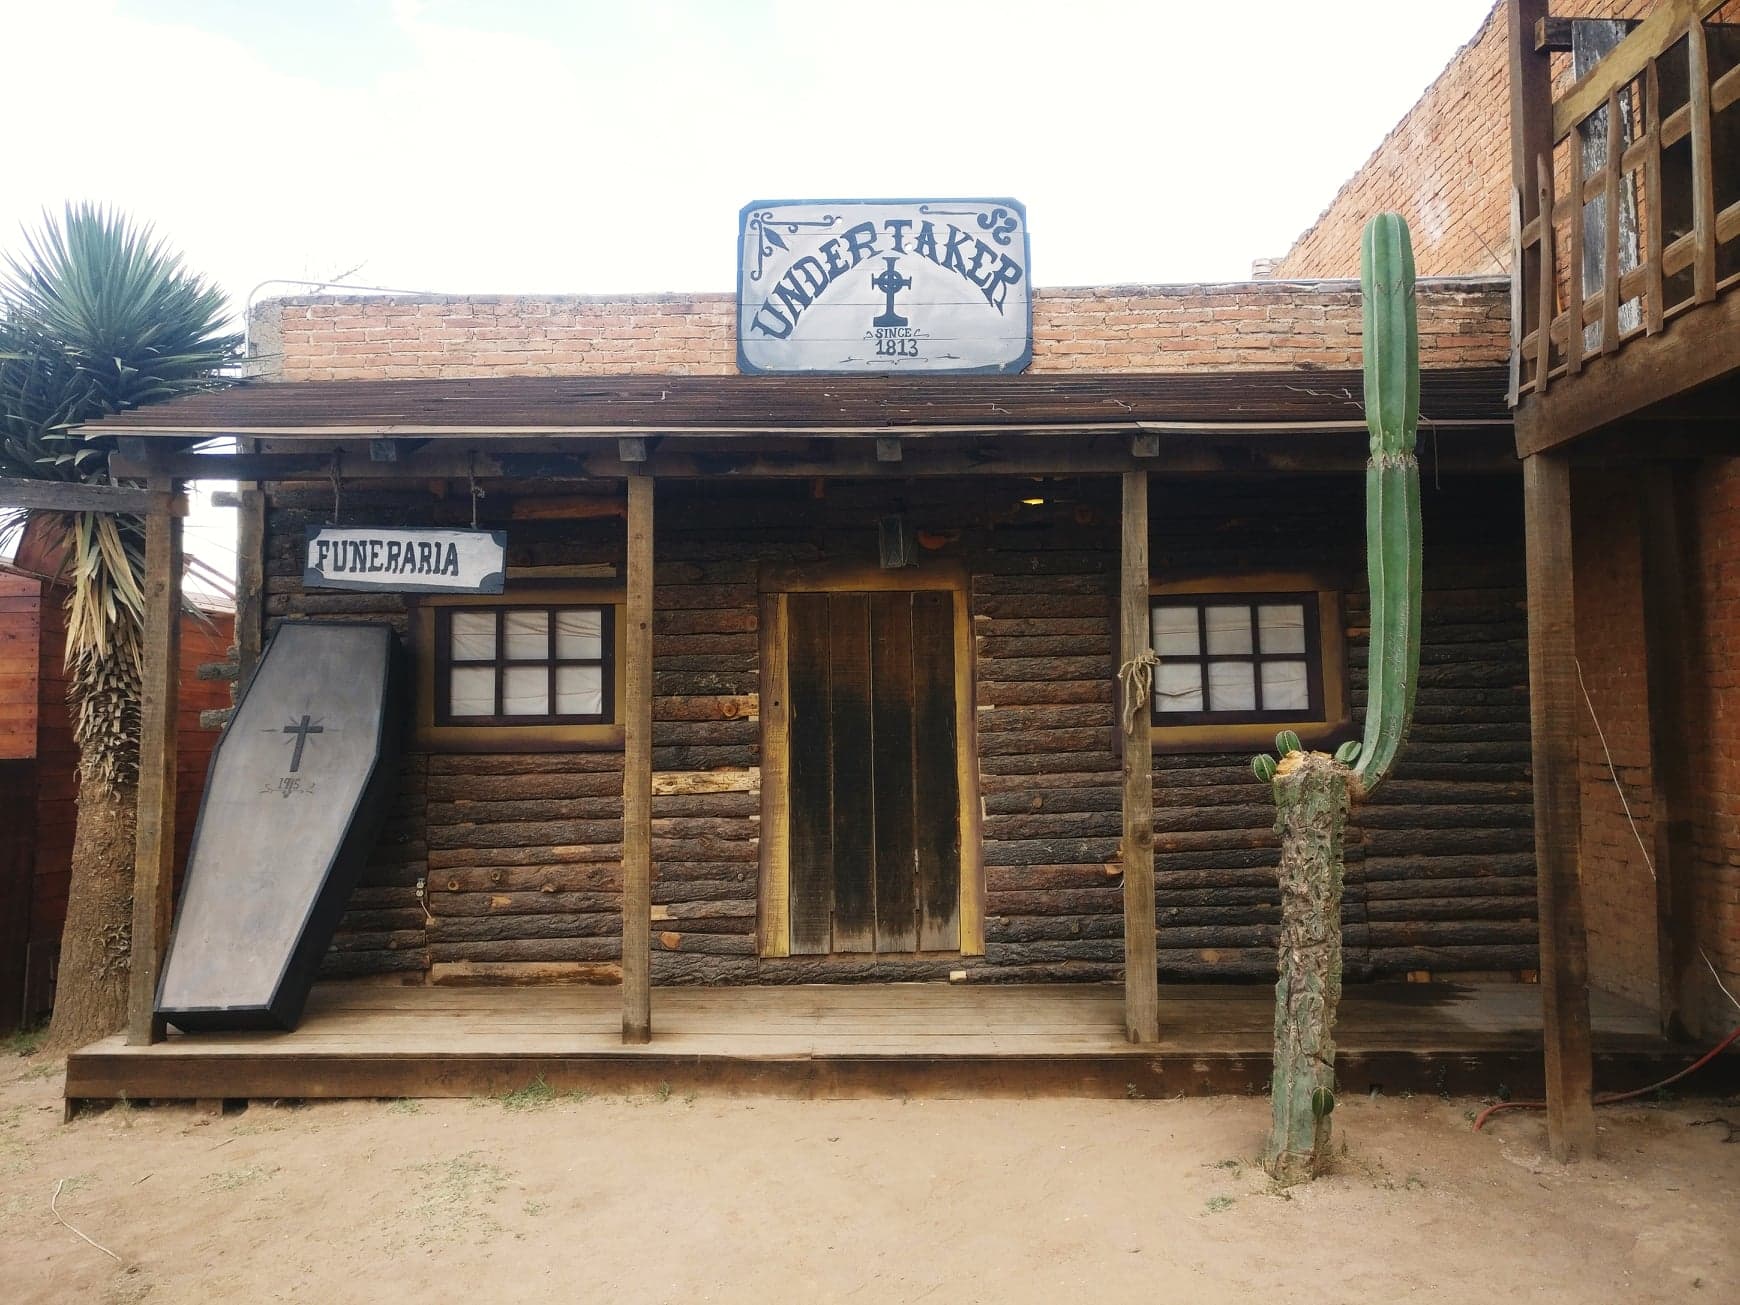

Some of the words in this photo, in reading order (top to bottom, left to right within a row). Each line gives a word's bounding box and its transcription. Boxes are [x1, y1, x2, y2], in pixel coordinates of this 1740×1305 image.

[751, 219, 1023, 340] UNDERTAKER
[875, 327, 912, 338] SINCE
[875, 338, 919, 358] 1813
[316, 540, 459, 577] FUNERARIA
